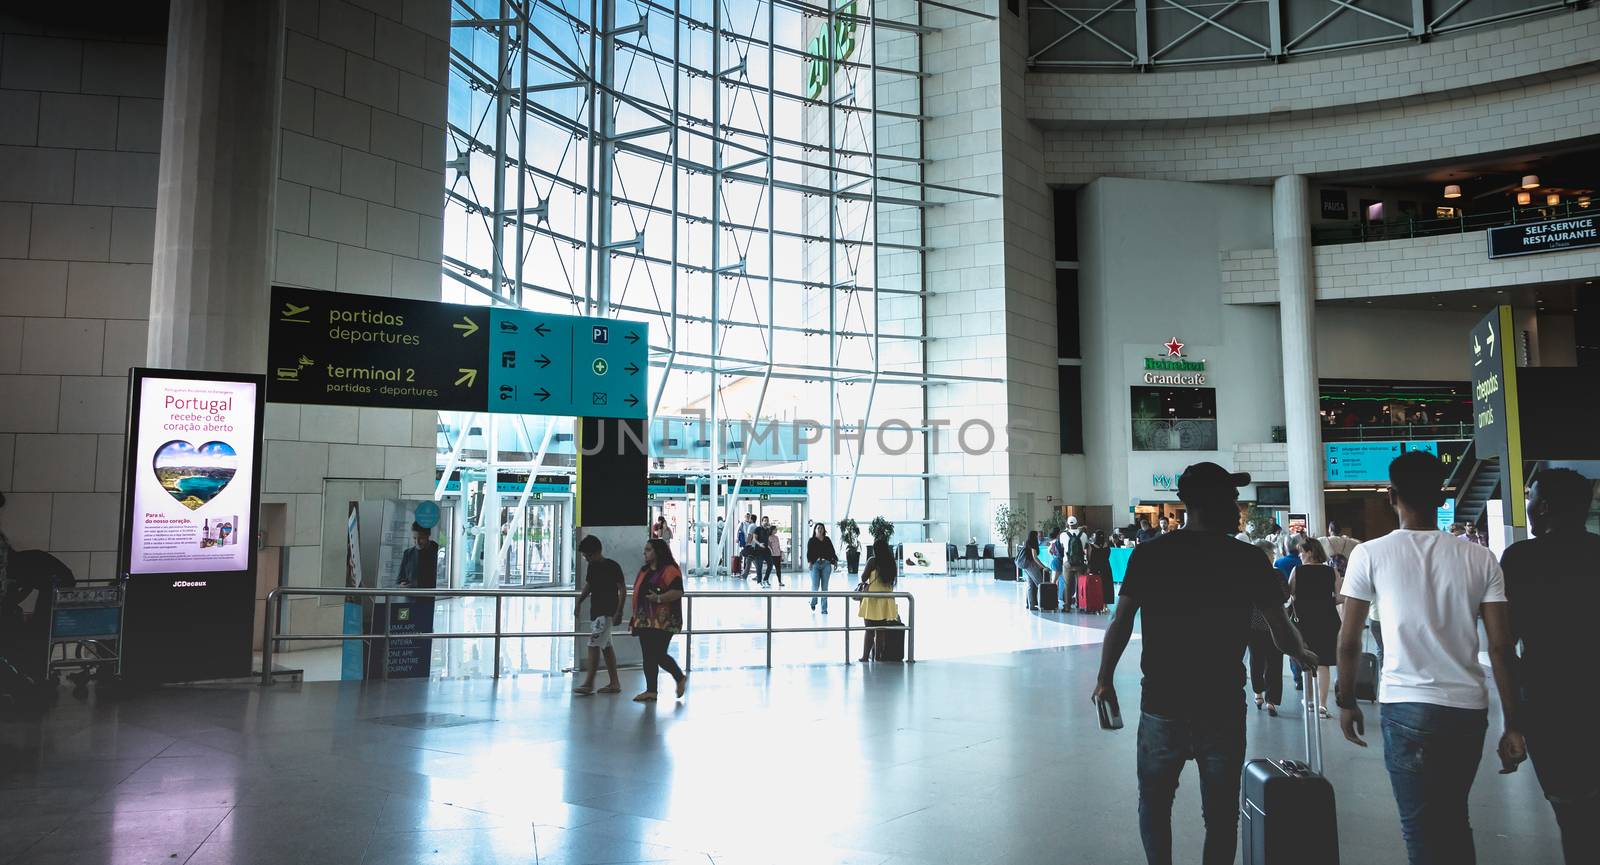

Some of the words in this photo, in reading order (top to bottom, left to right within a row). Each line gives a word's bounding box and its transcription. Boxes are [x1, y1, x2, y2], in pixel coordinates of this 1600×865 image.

[1525, 219, 1593, 235] SELF-SERVICE
[1523, 228, 1598, 246] RESTAURANTE
[329, 309, 404, 327] partidas
[329, 326, 420, 346] departures
[593, 328, 607, 342] P1
[327, 363, 401, 381] terminal
[406, 368, 416, 383] 2
[326, 383, 371, 394] partidas
[379, 385, 439, 397] departures
[1476, 371, 1499, 403] chegadas
[165, 395, 232, 415] Portugal
[170, 413, 211, 422] recebe-o
[213, 414, 226, 423] de
[1478, 404, 1494, 429] arrivals
[163, 422, 201, 432] coração
[202, 423, 234, 432] aberto
[1152, 474, 1172, 489] My
[172, 580, 207, 588] JCDecaux
